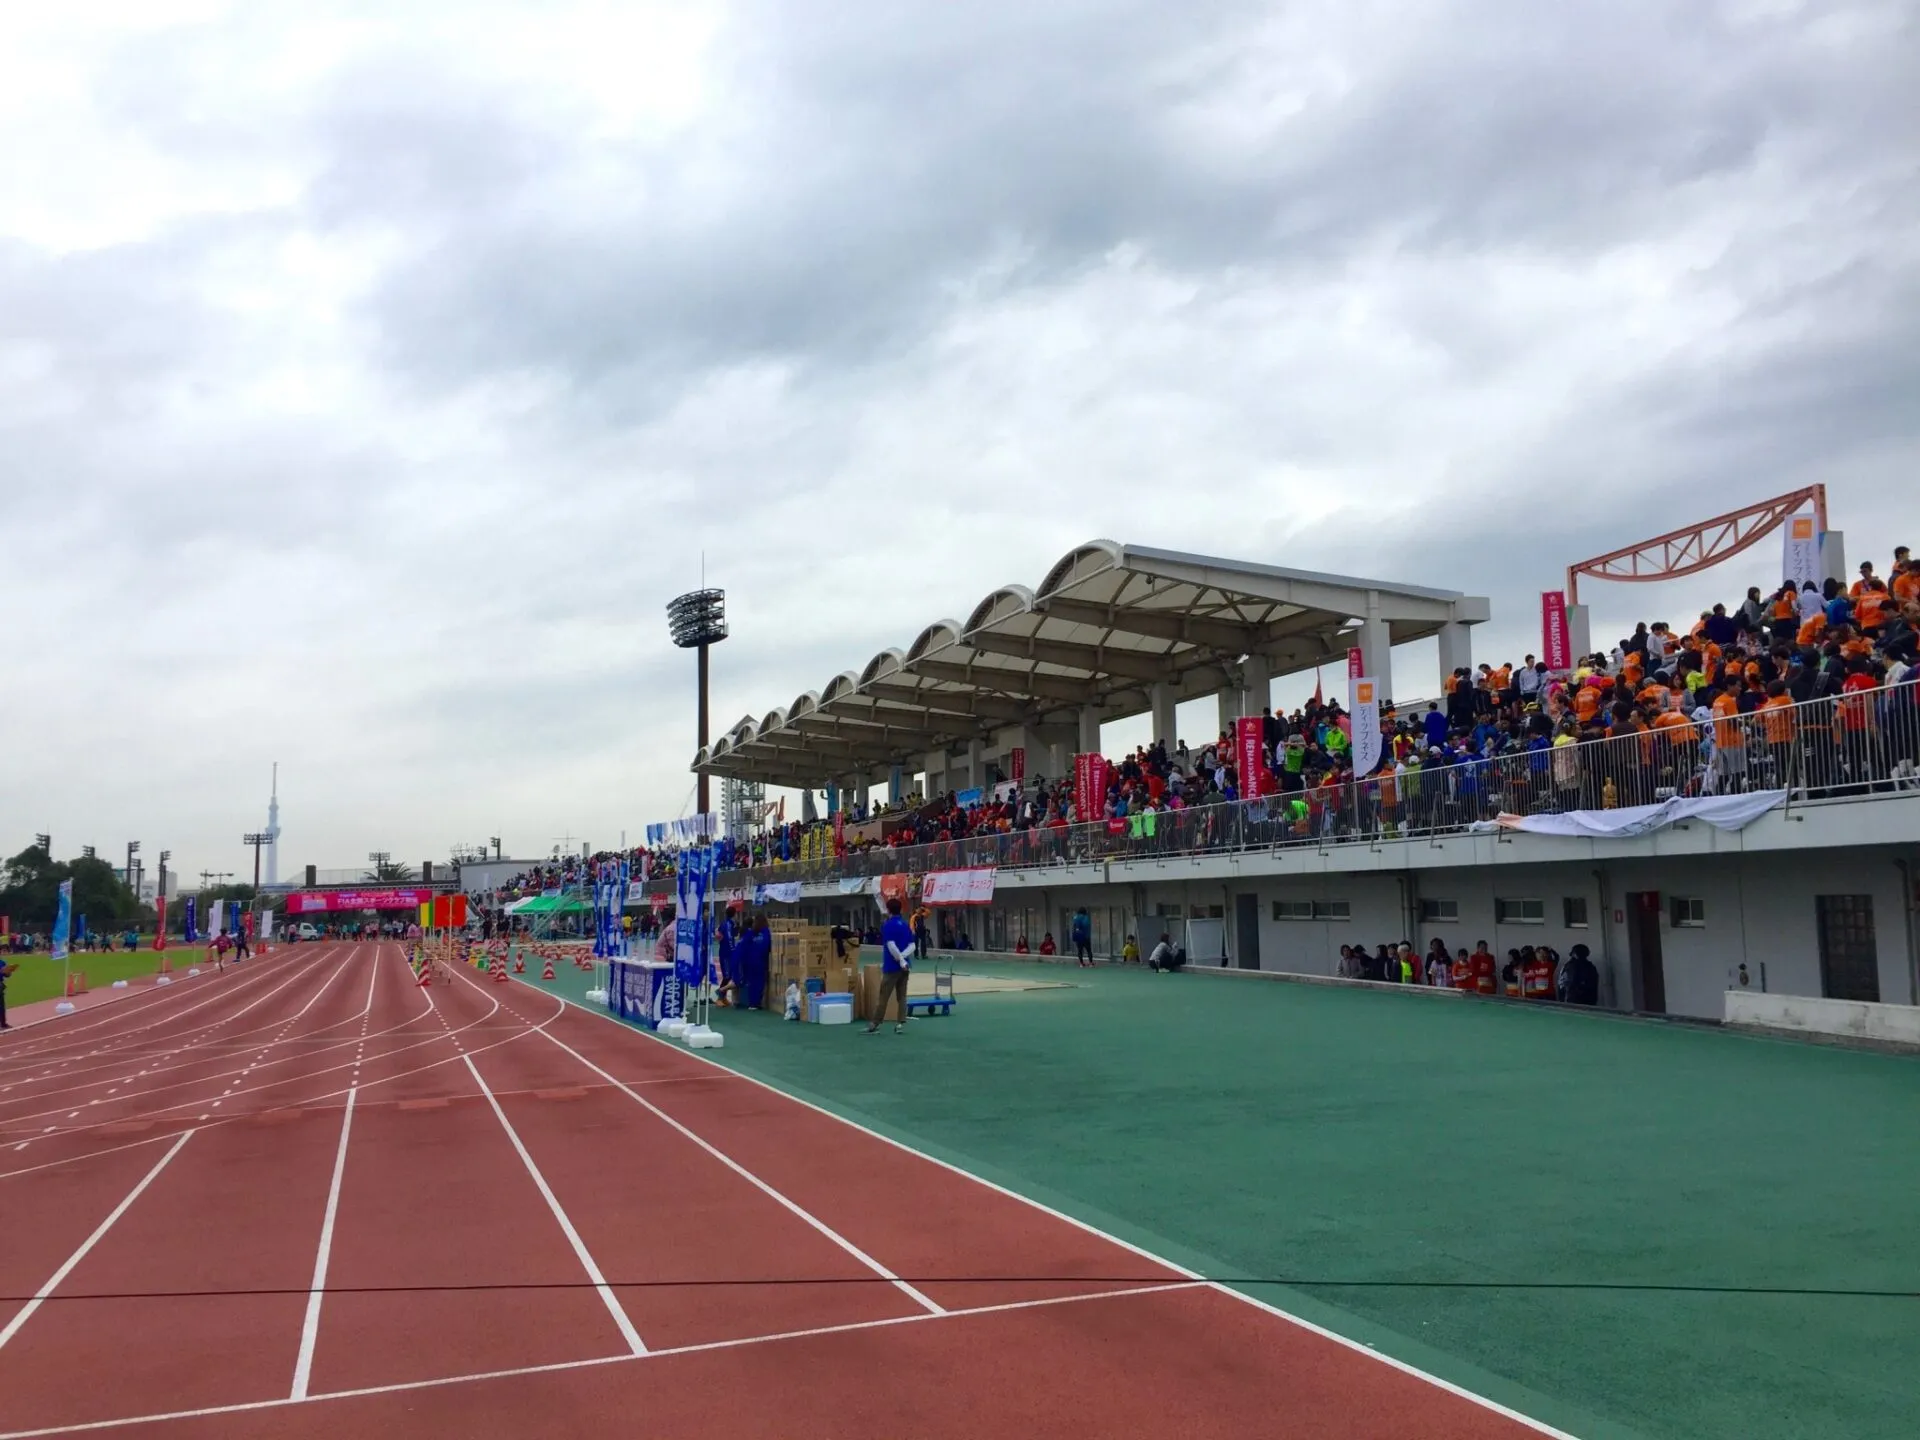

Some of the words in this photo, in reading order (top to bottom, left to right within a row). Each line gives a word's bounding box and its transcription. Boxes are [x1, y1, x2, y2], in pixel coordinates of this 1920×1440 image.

[1550, 610, 1563, 668] RENAISSANCE
[1245, 739, 1257, 799] RENAISSANCE
[665, 975, 674, 1015] SWEAT
